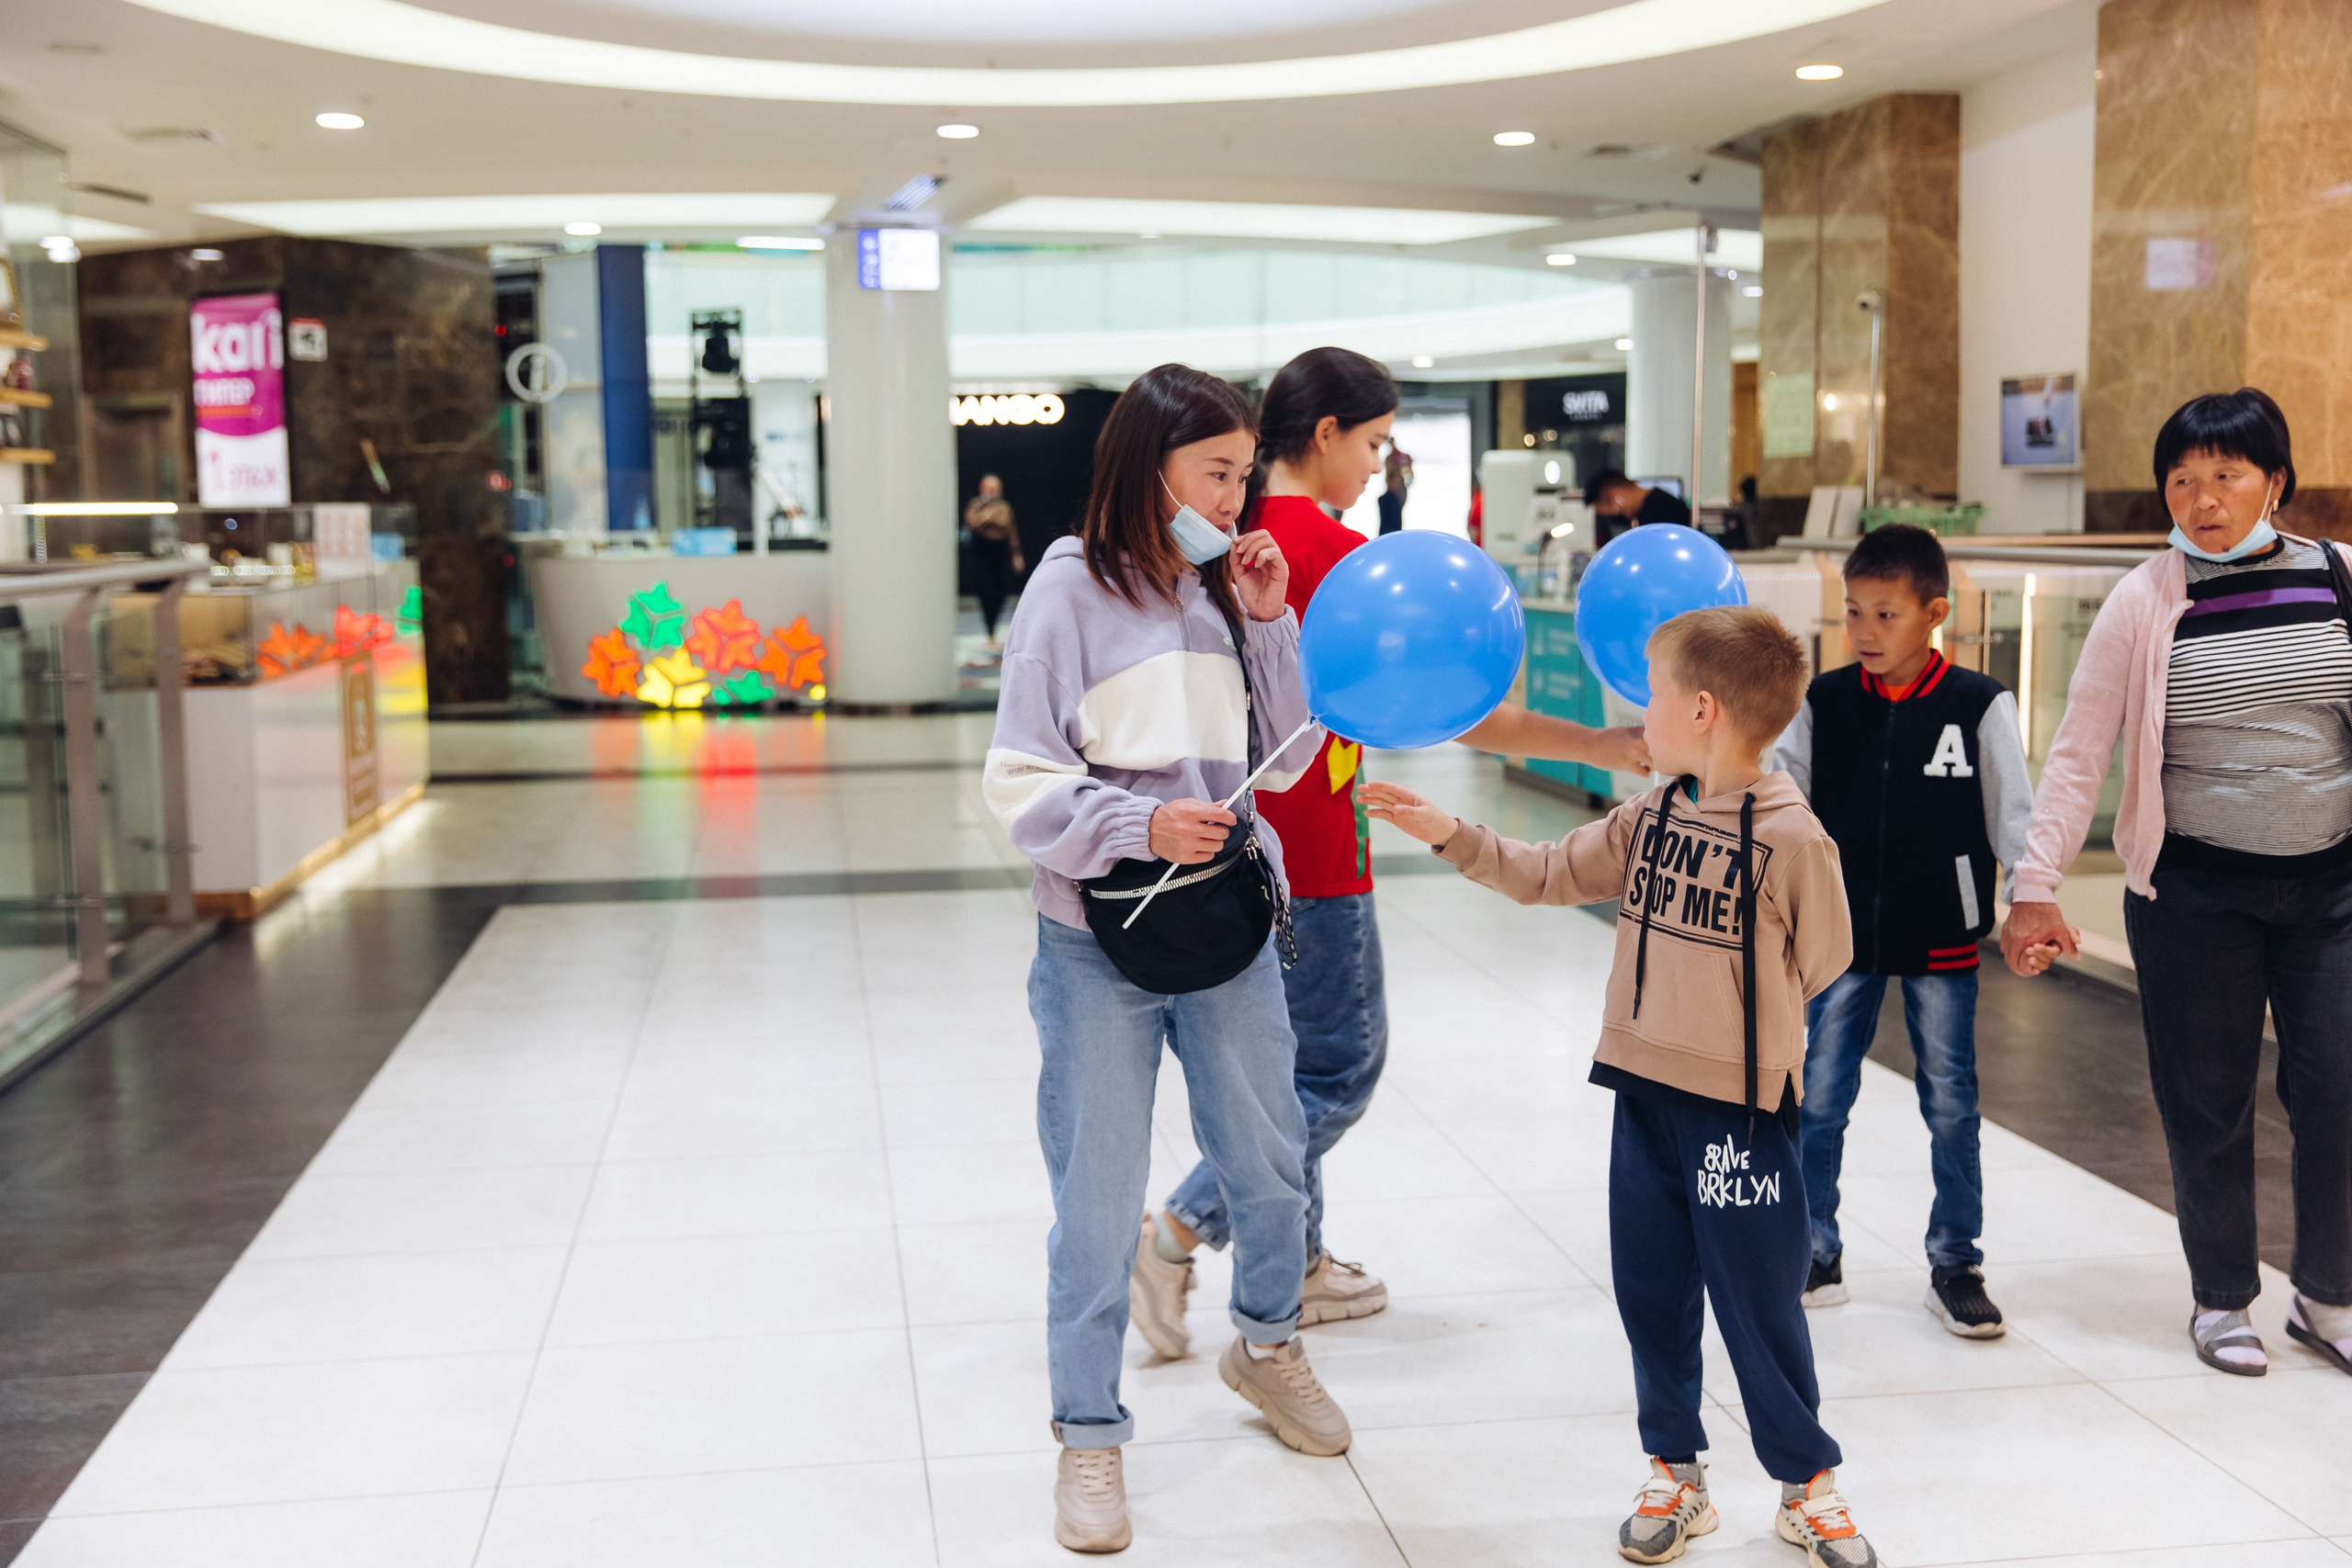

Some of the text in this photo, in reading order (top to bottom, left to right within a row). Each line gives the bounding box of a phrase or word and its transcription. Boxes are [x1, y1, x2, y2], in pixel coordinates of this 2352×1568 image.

[190, 308, 284, 373] kari
[1923, 723, 1973, 778] A
[1629, 865, 1744, 935] SOP ME!
[1697, 1168, 1781, 1209] BRKLYN
